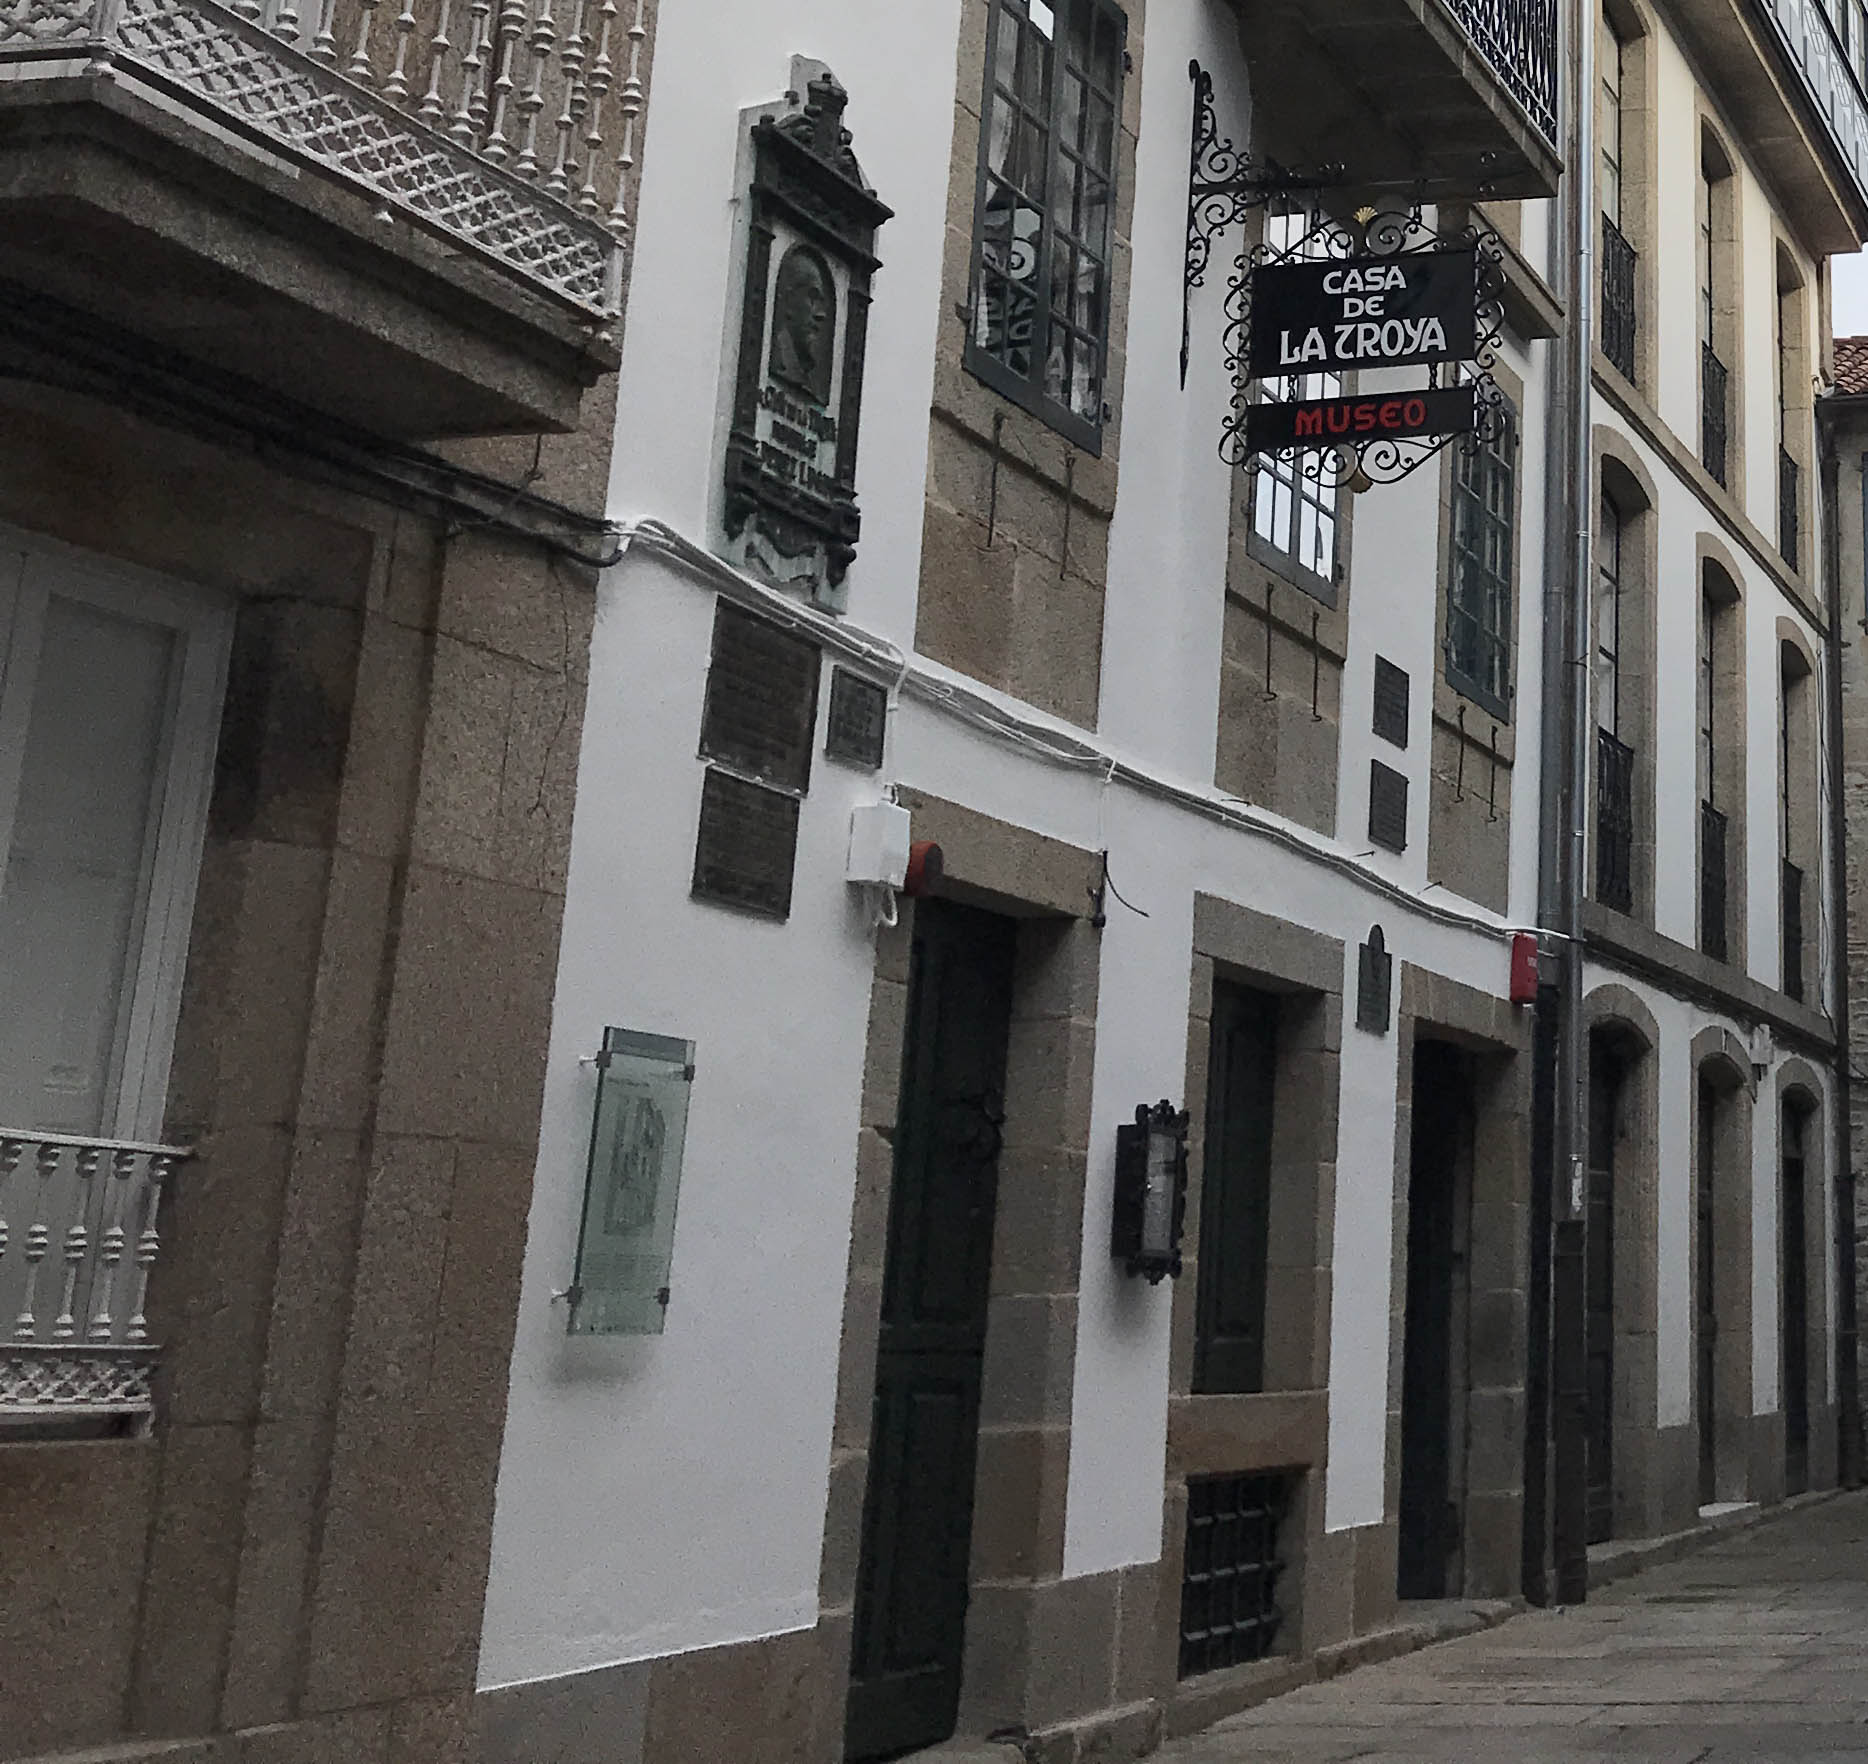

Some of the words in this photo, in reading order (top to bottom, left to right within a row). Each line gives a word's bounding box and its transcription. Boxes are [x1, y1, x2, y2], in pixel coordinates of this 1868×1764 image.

[1322, 265, 1407, 294] CASA
[1343, 296, 1385, 318] DE
[1279, 327, 1328, 365] LA
[1334, 317, 1447, 360] TROYA
[1294, 399, 1427, 436] MUSEO
